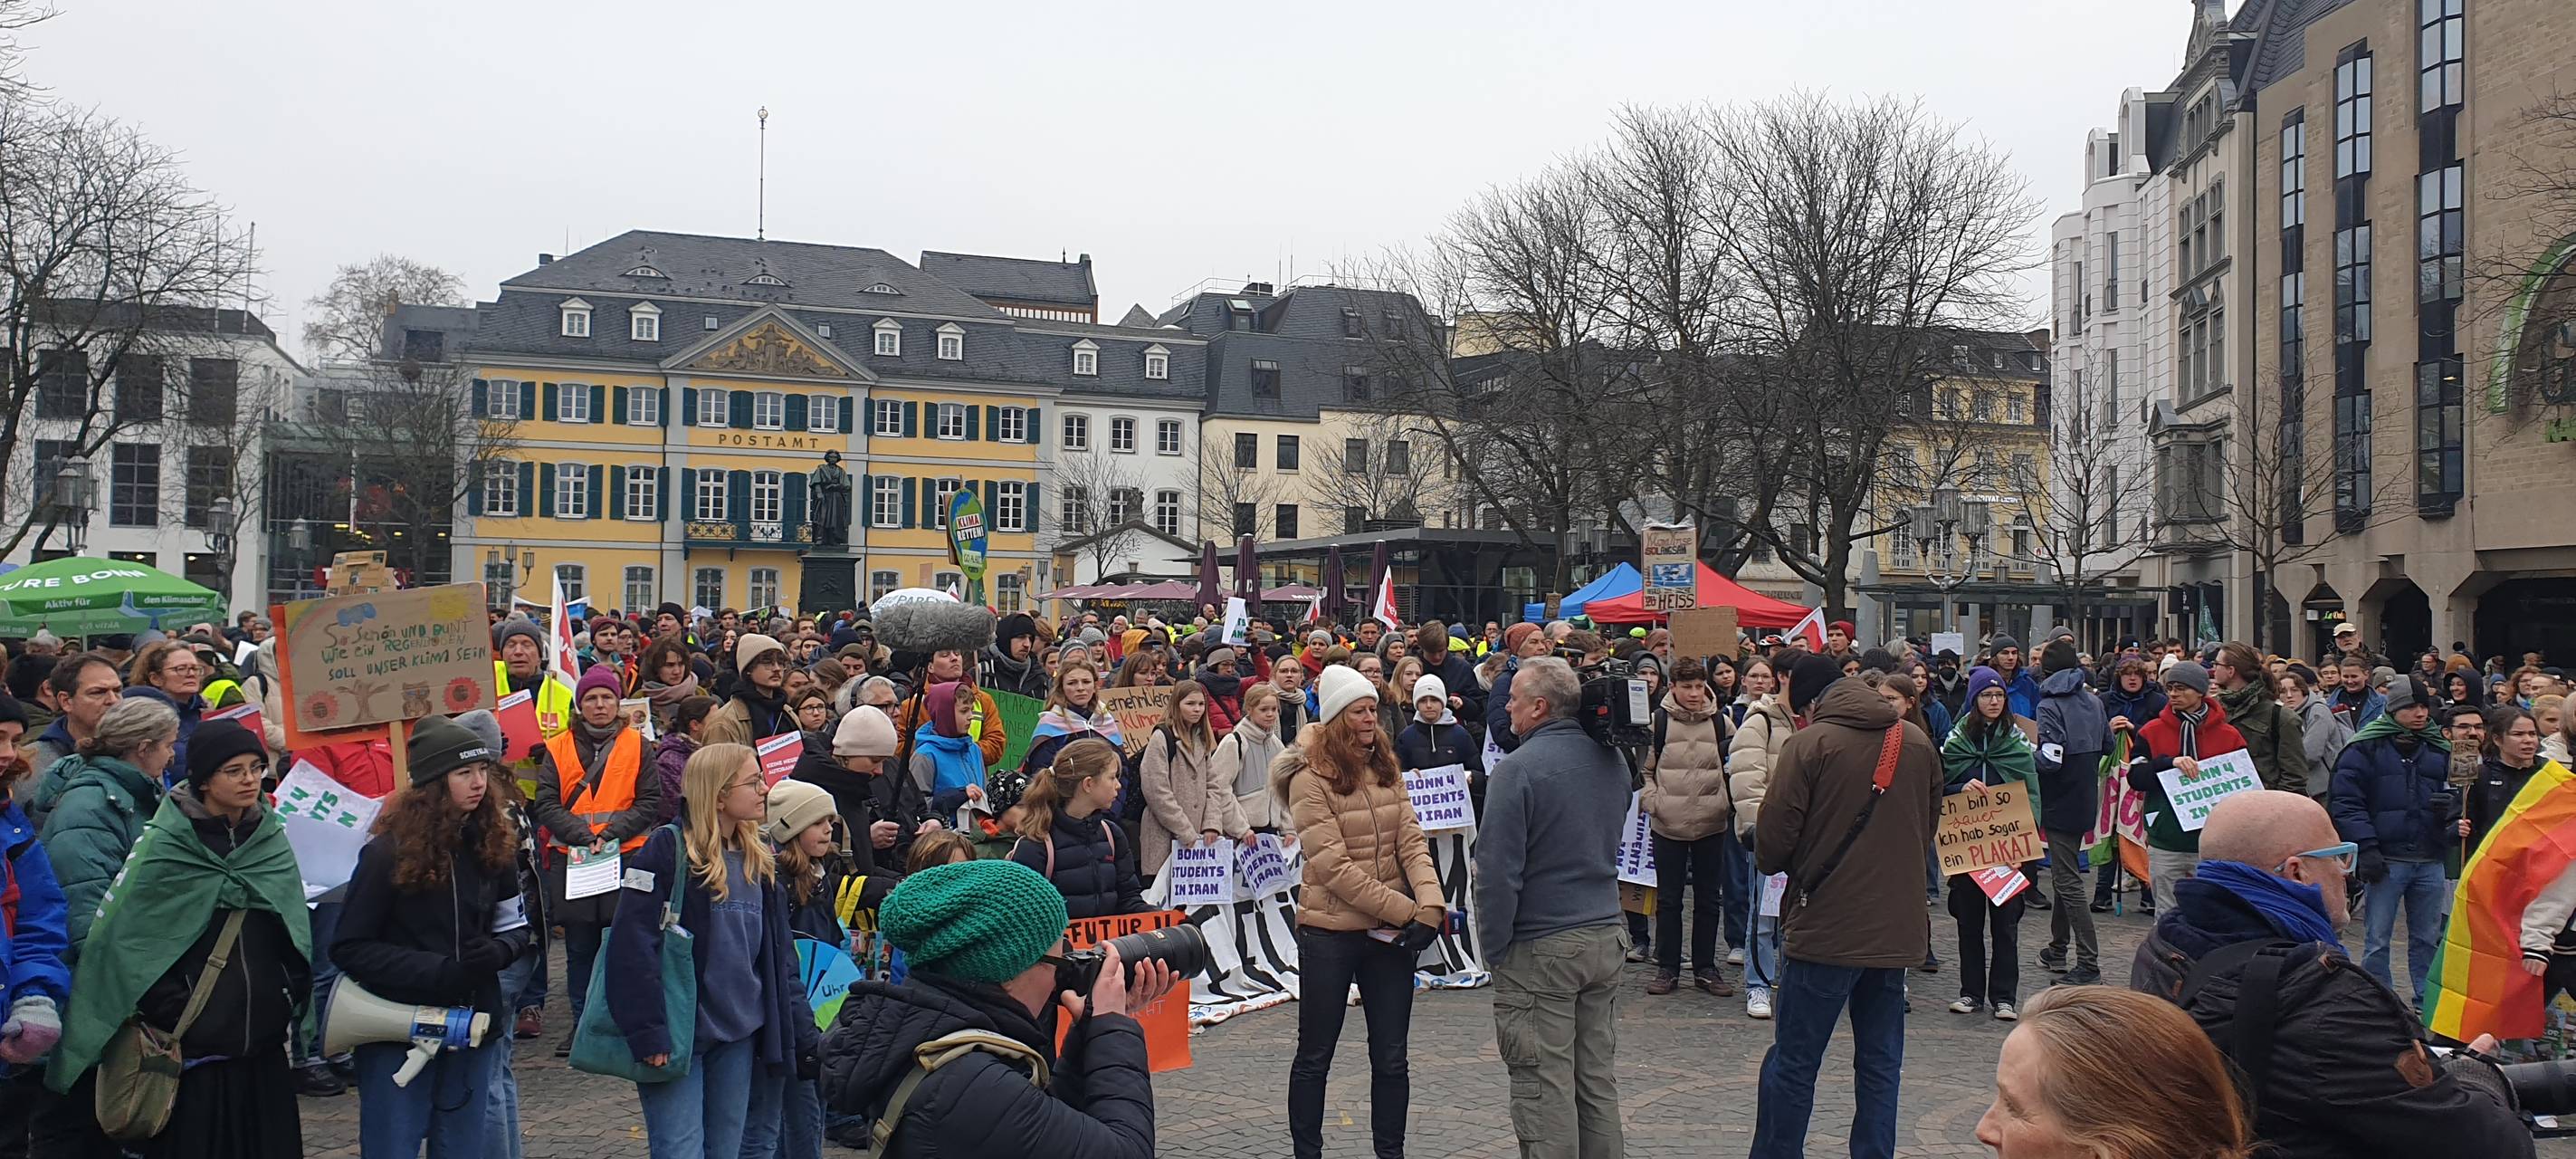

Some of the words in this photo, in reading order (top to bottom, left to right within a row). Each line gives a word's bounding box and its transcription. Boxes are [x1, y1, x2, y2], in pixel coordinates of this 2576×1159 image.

[719, 434, 818, 449] POSTAMT
[957, 514, 979, 529] KLIMA
[956, 526, 985, 541] RETTEN!
[72, 569, 148, 586] BONN
[44, 599, 74, 609] Aktiv
[75, 598, 91, 608] für
[144, 595, 160, 605] den
[1658, 593, 1695, 609] HEISS
[401, 623, 426, 638] UND
[328, 666, 357, 682] SOLL
[366, 656, 408, 676] UNSER
[2222, 761, 2235, 773] 4
[1406, 776, 1445, 790] BONN
[1445, 774, 1455, 785] 4
[2173, 775, 2253, 807] STUDENTS
[1966, 794, 1989, 811] bin
[1426, 806, 1463, 822] IRAN
[1947, 809, 2003, 830] sauer
[2188, 807, 2209, 820] IN
[1938, 830, 1958, 848] Ich
[1961, 827, 1984, 844] hab
[1989, 819, 2020, 837] sogar
[1261, 839, 1271, 849] 4
[1943, 853, 1964, 867] ein
[1968, 831, 2033, 867] PLAKAT
[1178, 848, 1207, 860] BONN
[1207, 848, 1216, 860] 4
[1171, 866, 1225, 878] STUDENTS
[1255, 866, 1283, 889] IRAN
[1174, 884, 1186, 896] IN
[1188, 883, 1219, 896] IRAN
[821, 983, 845, 998] Uhr
